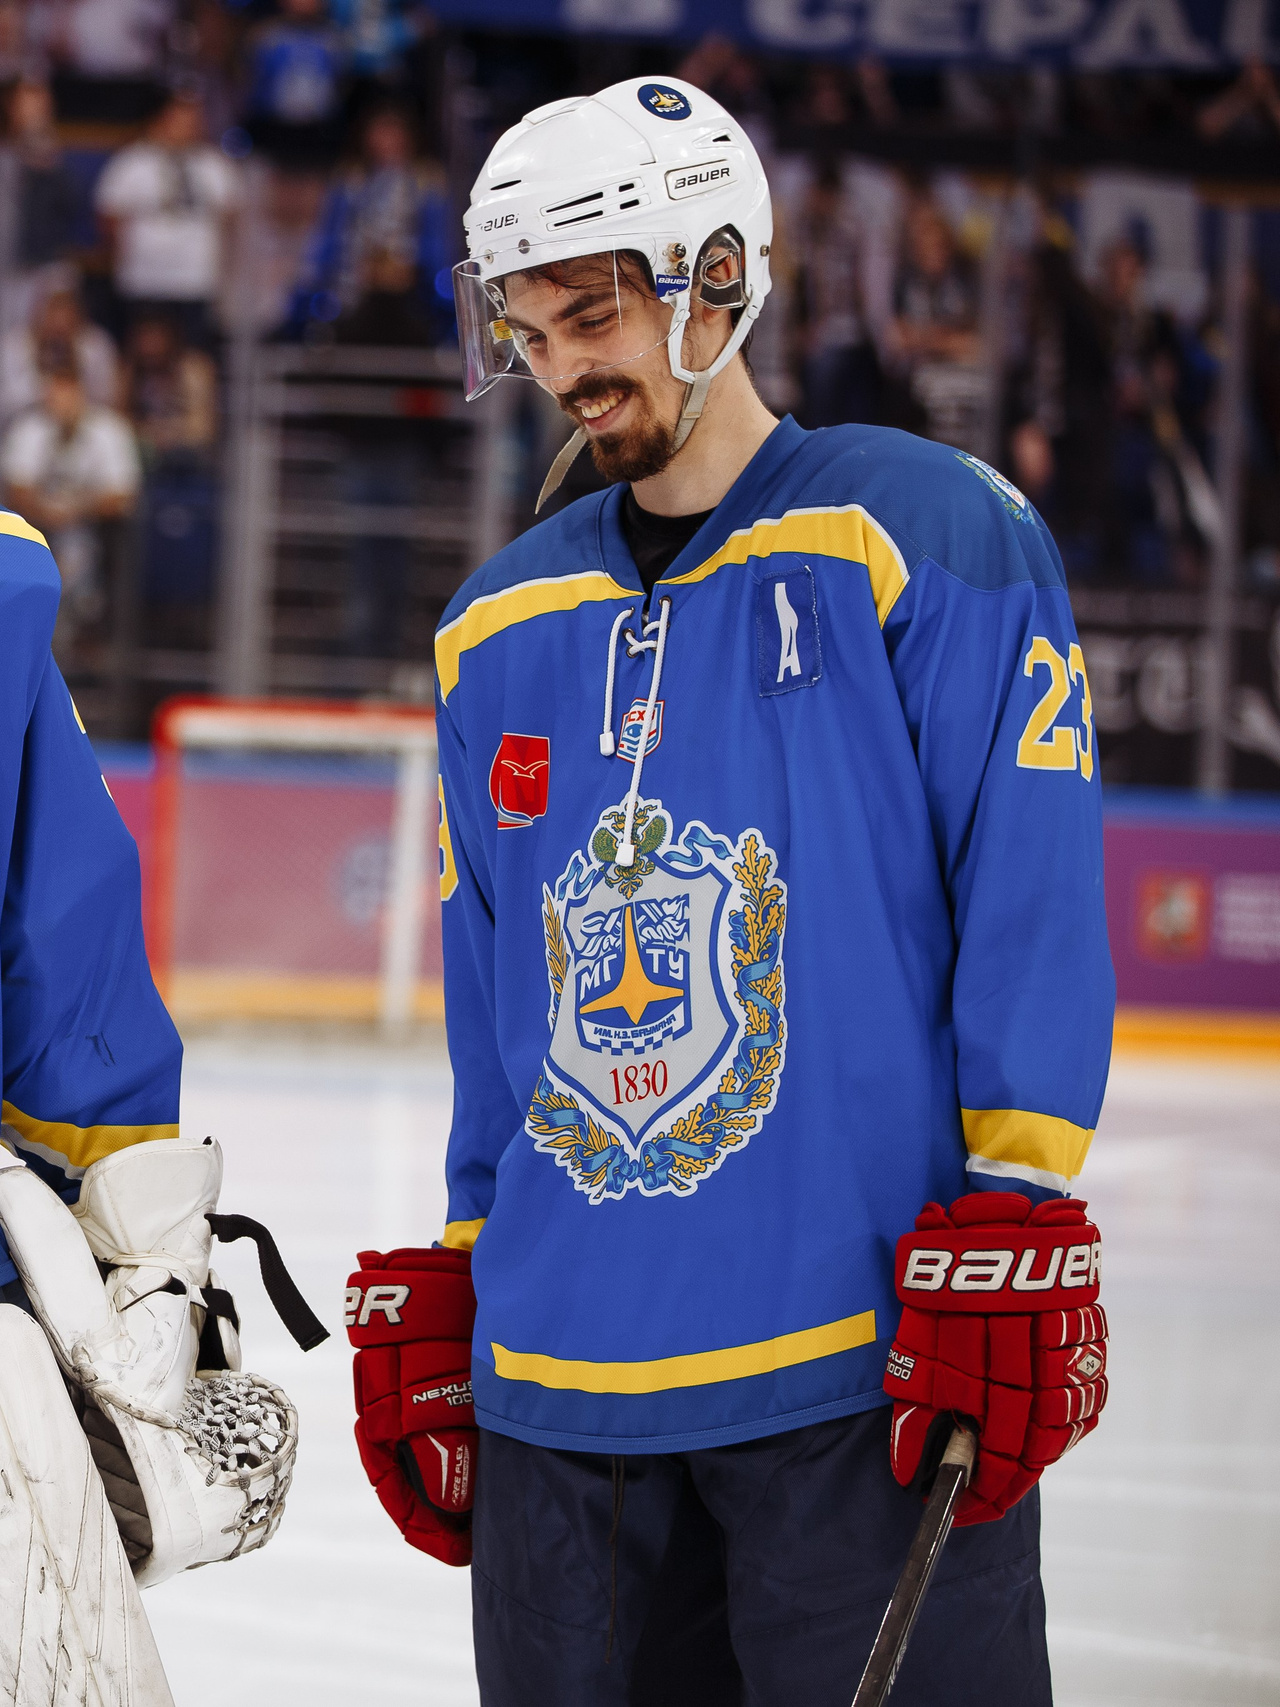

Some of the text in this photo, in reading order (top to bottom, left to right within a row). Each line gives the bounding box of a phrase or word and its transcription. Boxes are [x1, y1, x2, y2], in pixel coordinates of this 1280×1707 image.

[774, 582, 802, 683] A
[1016, 636, 1095, 782] 23
[631, 1014, 676, 1038] БАУМАНА
[609, 1060, 668, 1105] 1830
